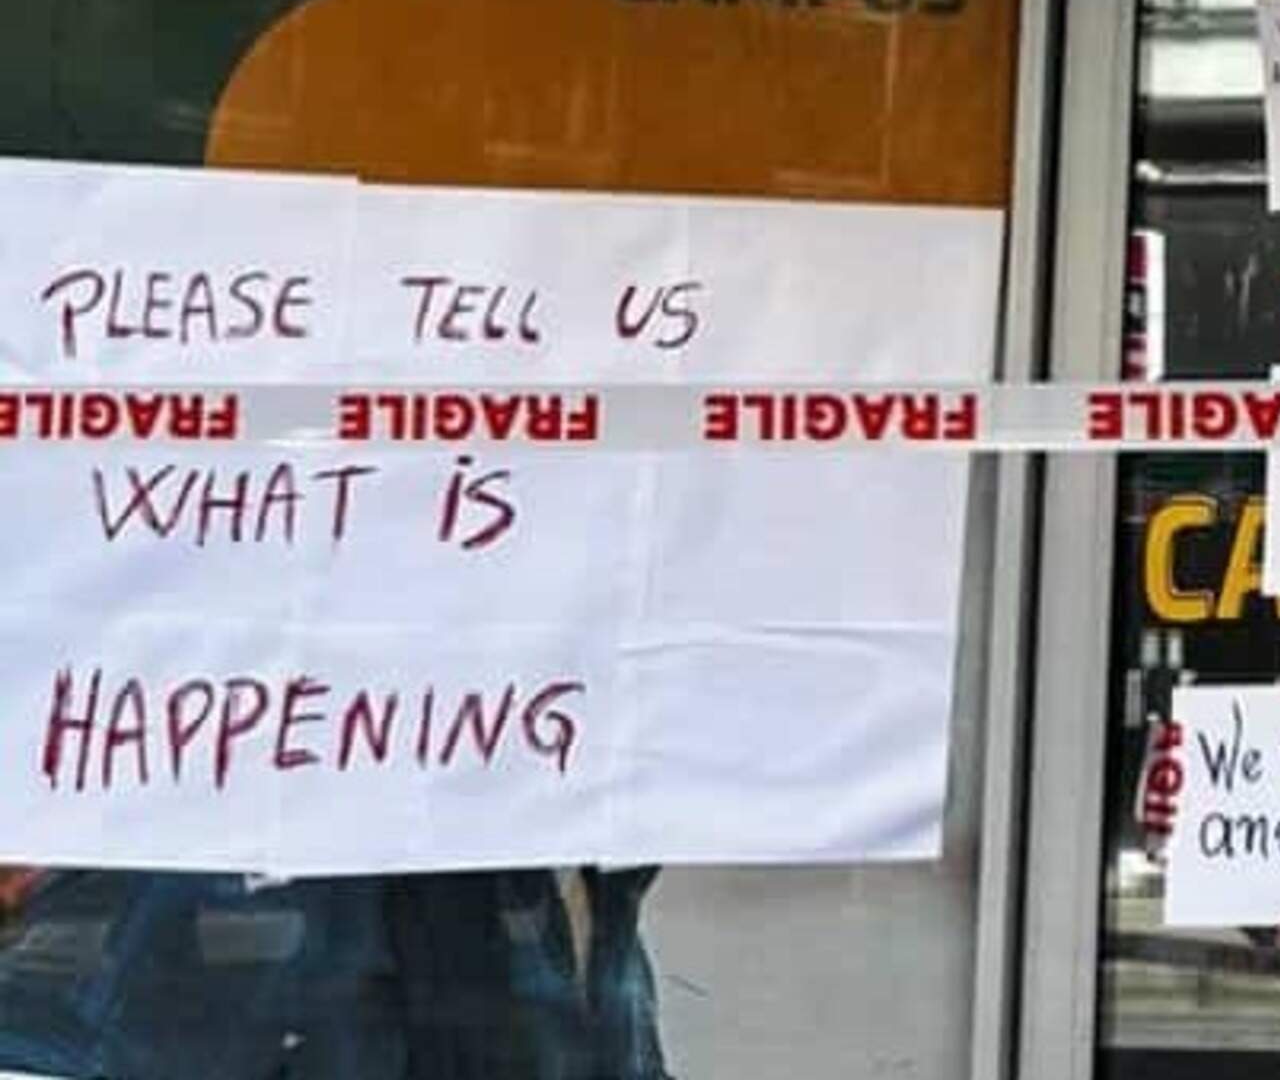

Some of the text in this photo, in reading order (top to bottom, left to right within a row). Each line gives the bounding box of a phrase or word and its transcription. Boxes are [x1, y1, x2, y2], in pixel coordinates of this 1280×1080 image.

[42, 268, 312, 358] PLEASE
[616, 282, 702, 348] US
[338, 394, 598, 441] FRAGILE
[703, 394, 978, 441] FRAGILE
[92, 463, 378, 546] WHAT
[42, 668, 586, 792] HAPPENING
[1198, 696, 1262, 794] We
